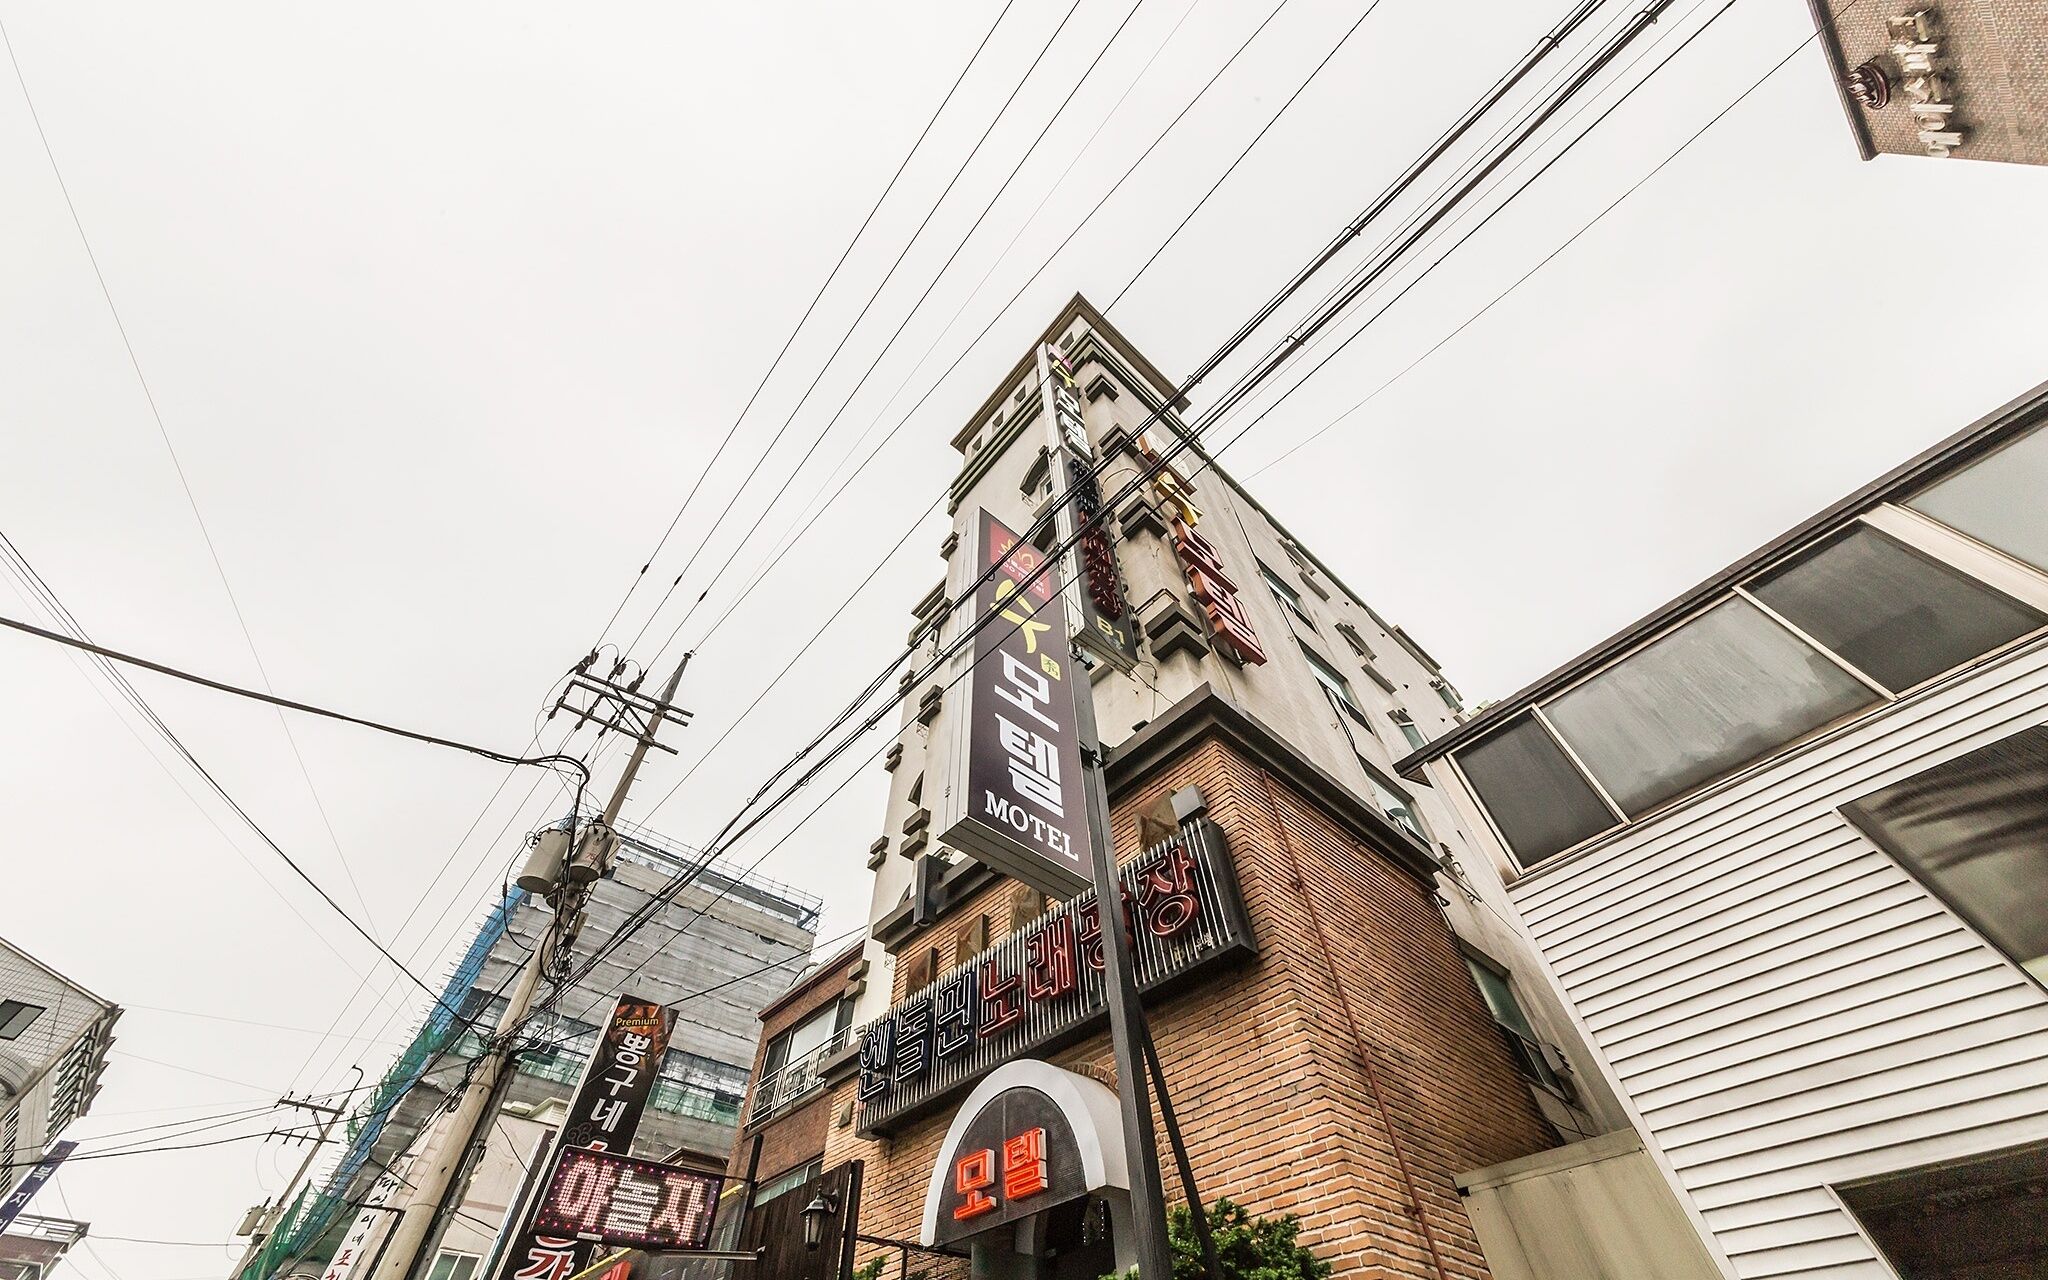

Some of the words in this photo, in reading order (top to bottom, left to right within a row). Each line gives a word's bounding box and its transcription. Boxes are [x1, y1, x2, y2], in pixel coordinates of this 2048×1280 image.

[1096, 615, 1126, 644] B1
[984, 789, 1079, 862] MOTEL
[615, 1017, 659, 1027] Premium
[590, 1032, 651, 1133] 뽕구네
[557, 1160, 705, 1241] 야놀자
[953, 1125, 1049, 1221] 모텔
